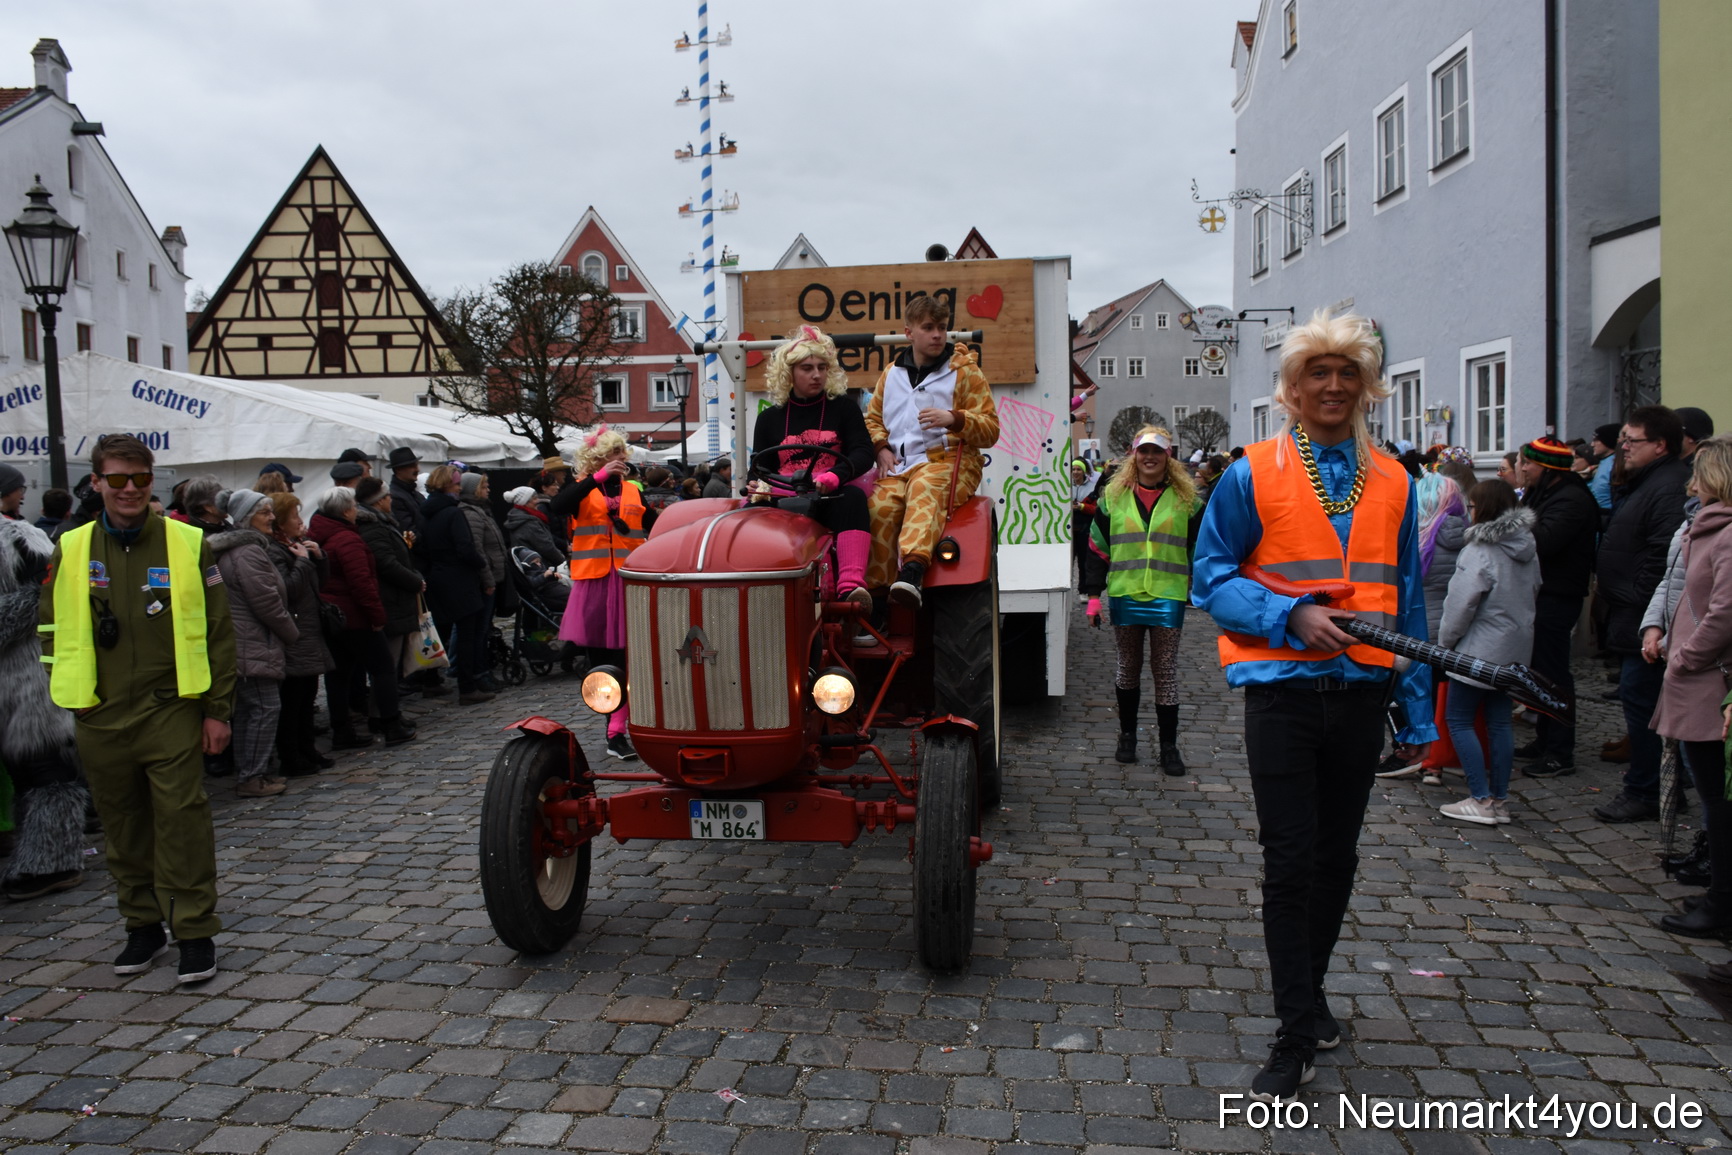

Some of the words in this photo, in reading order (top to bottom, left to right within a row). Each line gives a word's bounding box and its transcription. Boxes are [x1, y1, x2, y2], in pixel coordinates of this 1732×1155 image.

[132, 379, 211, 419] Gschrey
[2, 436, 50, 456] 0949
[74, 436, 86, 456] /
[98, 431, 170, 451] 001
[706, 803, 730, 819] NM
[701, 822, 712, 837] M
[722, 822, 756, 838] 864
